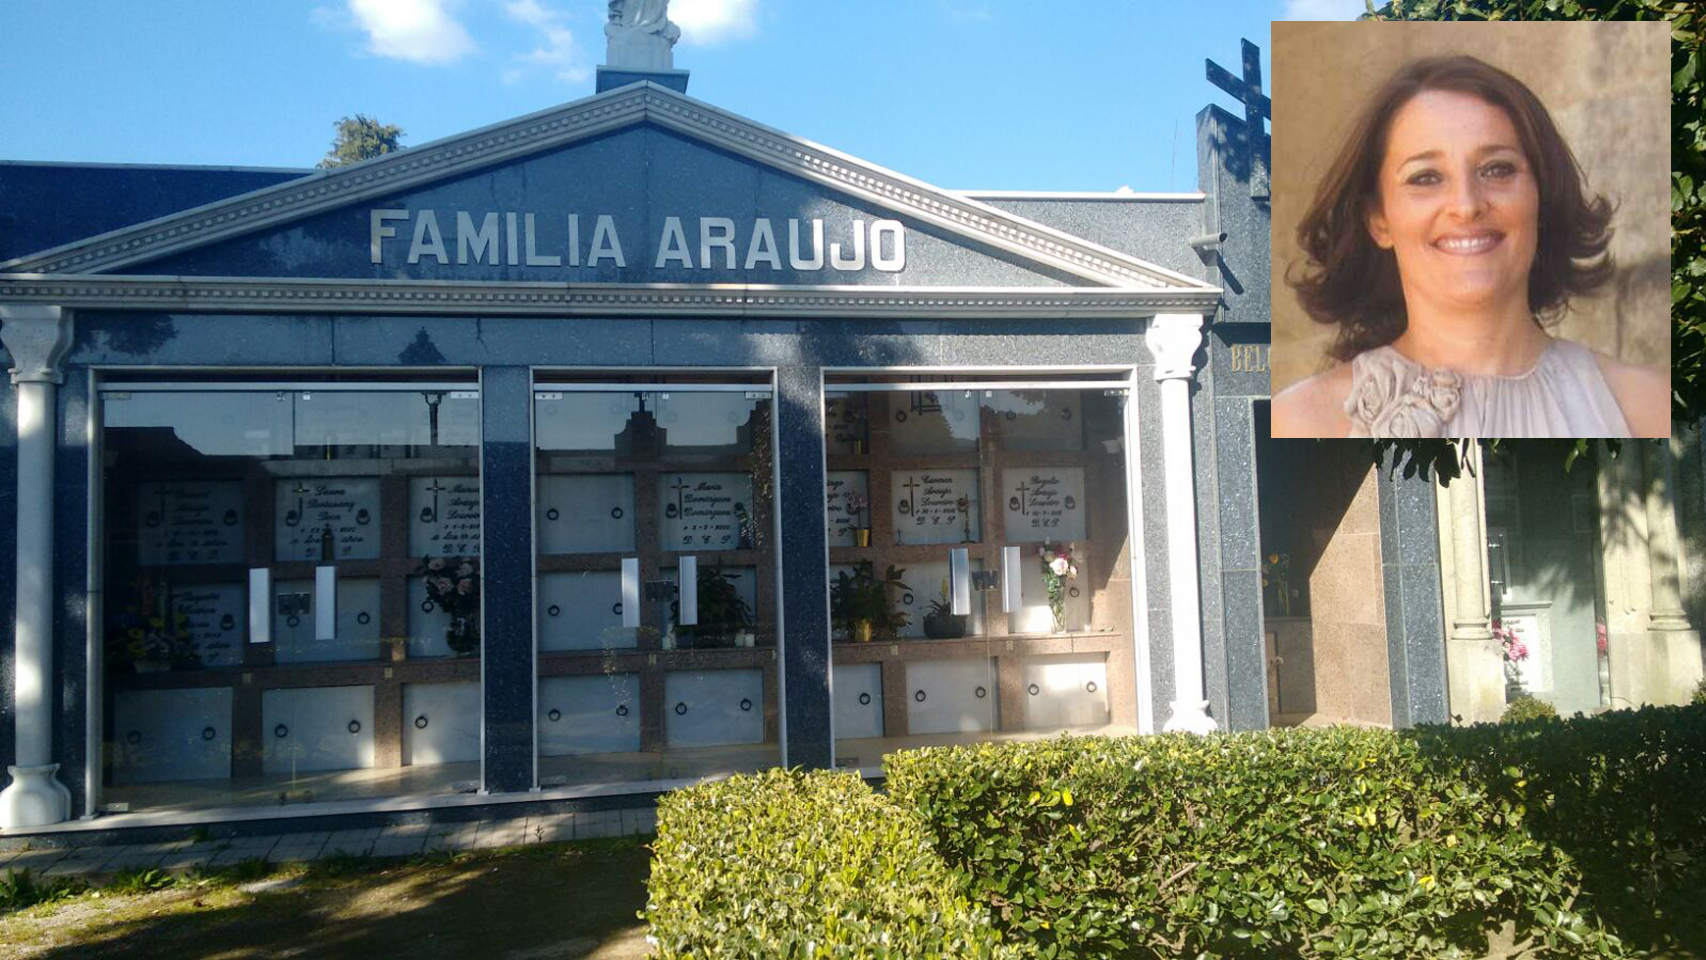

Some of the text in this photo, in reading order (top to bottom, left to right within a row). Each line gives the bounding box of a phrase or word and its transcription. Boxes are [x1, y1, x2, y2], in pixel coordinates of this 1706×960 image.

[370, 208, 906, 272] FAMILIA ARAUJO
[1231, 342, 1271, 374] BEL
